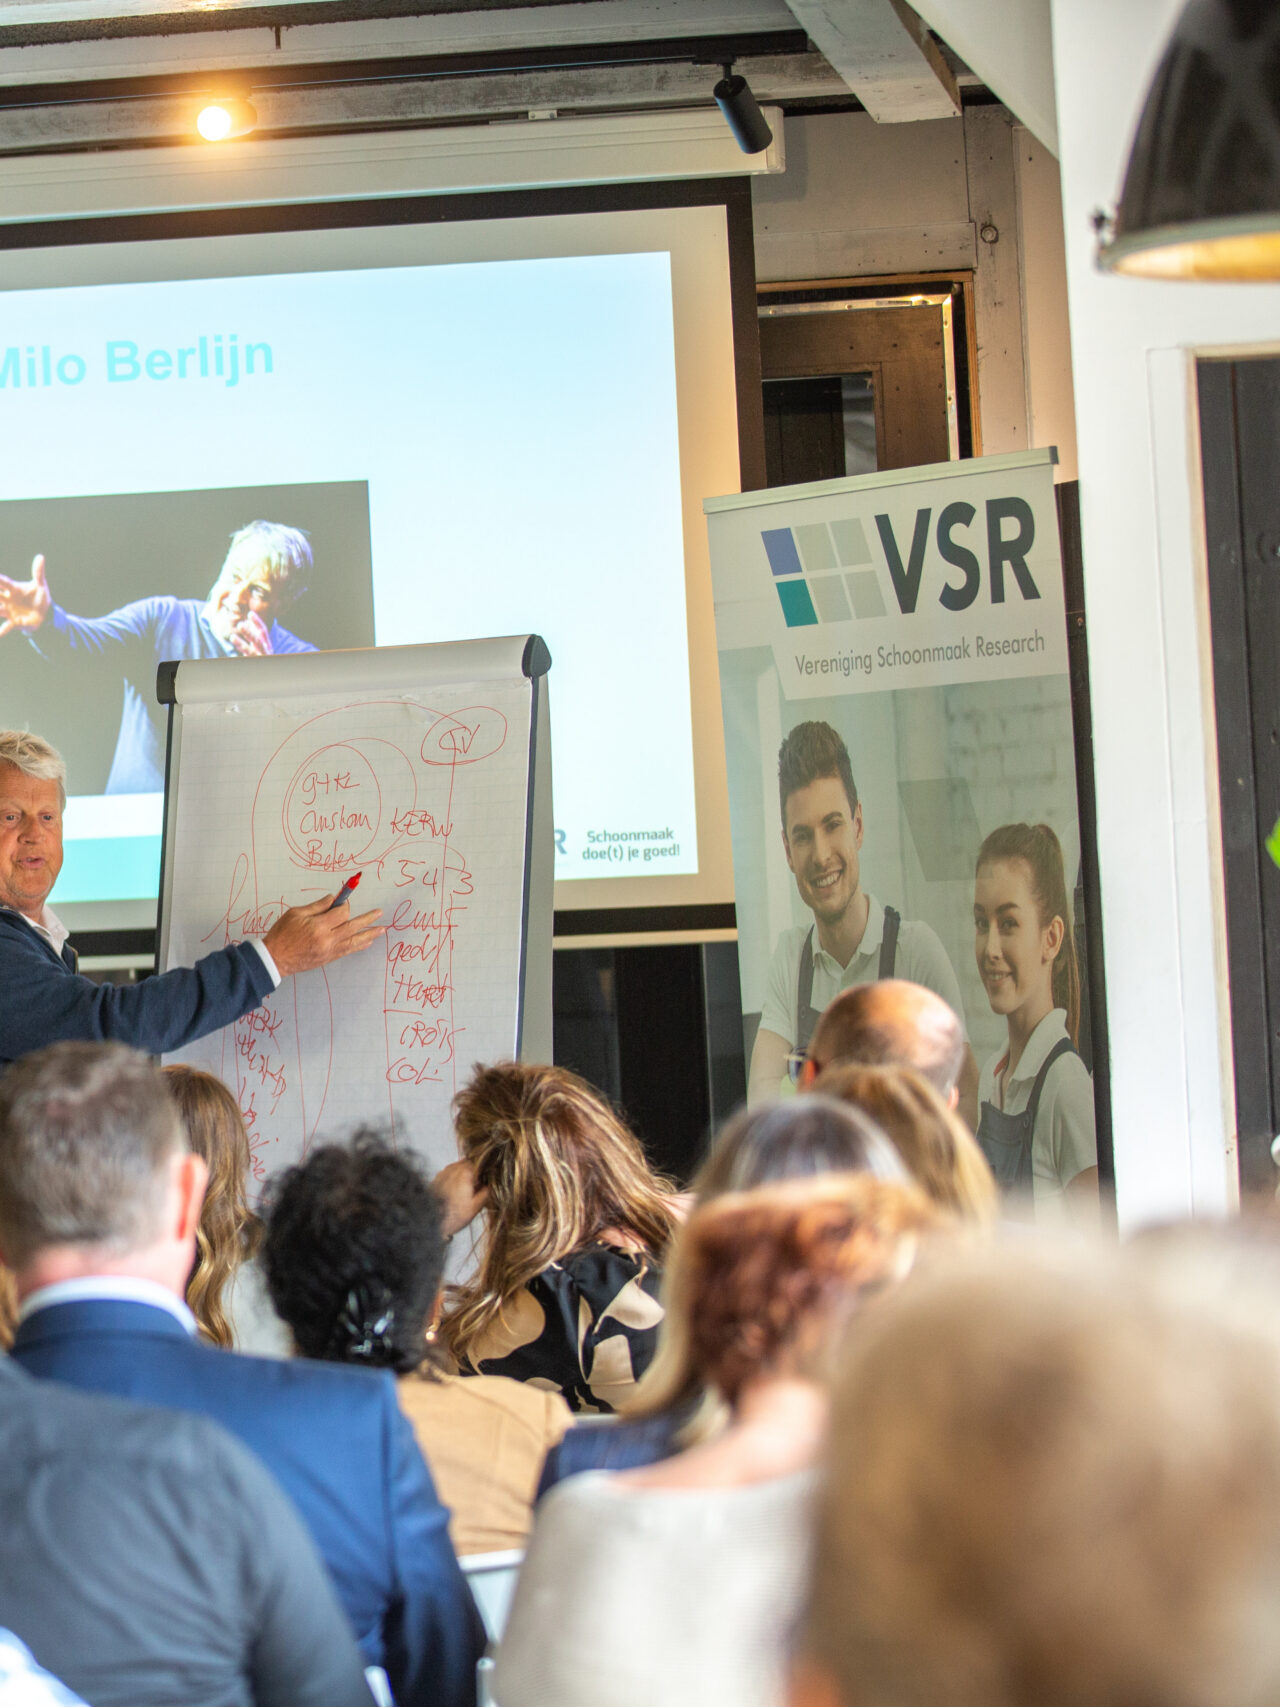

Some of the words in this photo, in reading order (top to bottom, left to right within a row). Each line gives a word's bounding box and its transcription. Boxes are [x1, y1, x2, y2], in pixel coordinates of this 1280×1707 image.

[106, 334, 274, 388] Berlijn
[874, 496, 1042, 614] VSR
[795, 651, 872, 677] Vereniging
[877, 635, 971, 668] Schoonmaak
[976, 629, 1045, 657] Research
[582, 844, 624, 862] doe(t)
[628, 845, 640, 861] je
[643, 844, 681, 861] goed!
[586, 826, 675, 844] Schoonmaak
